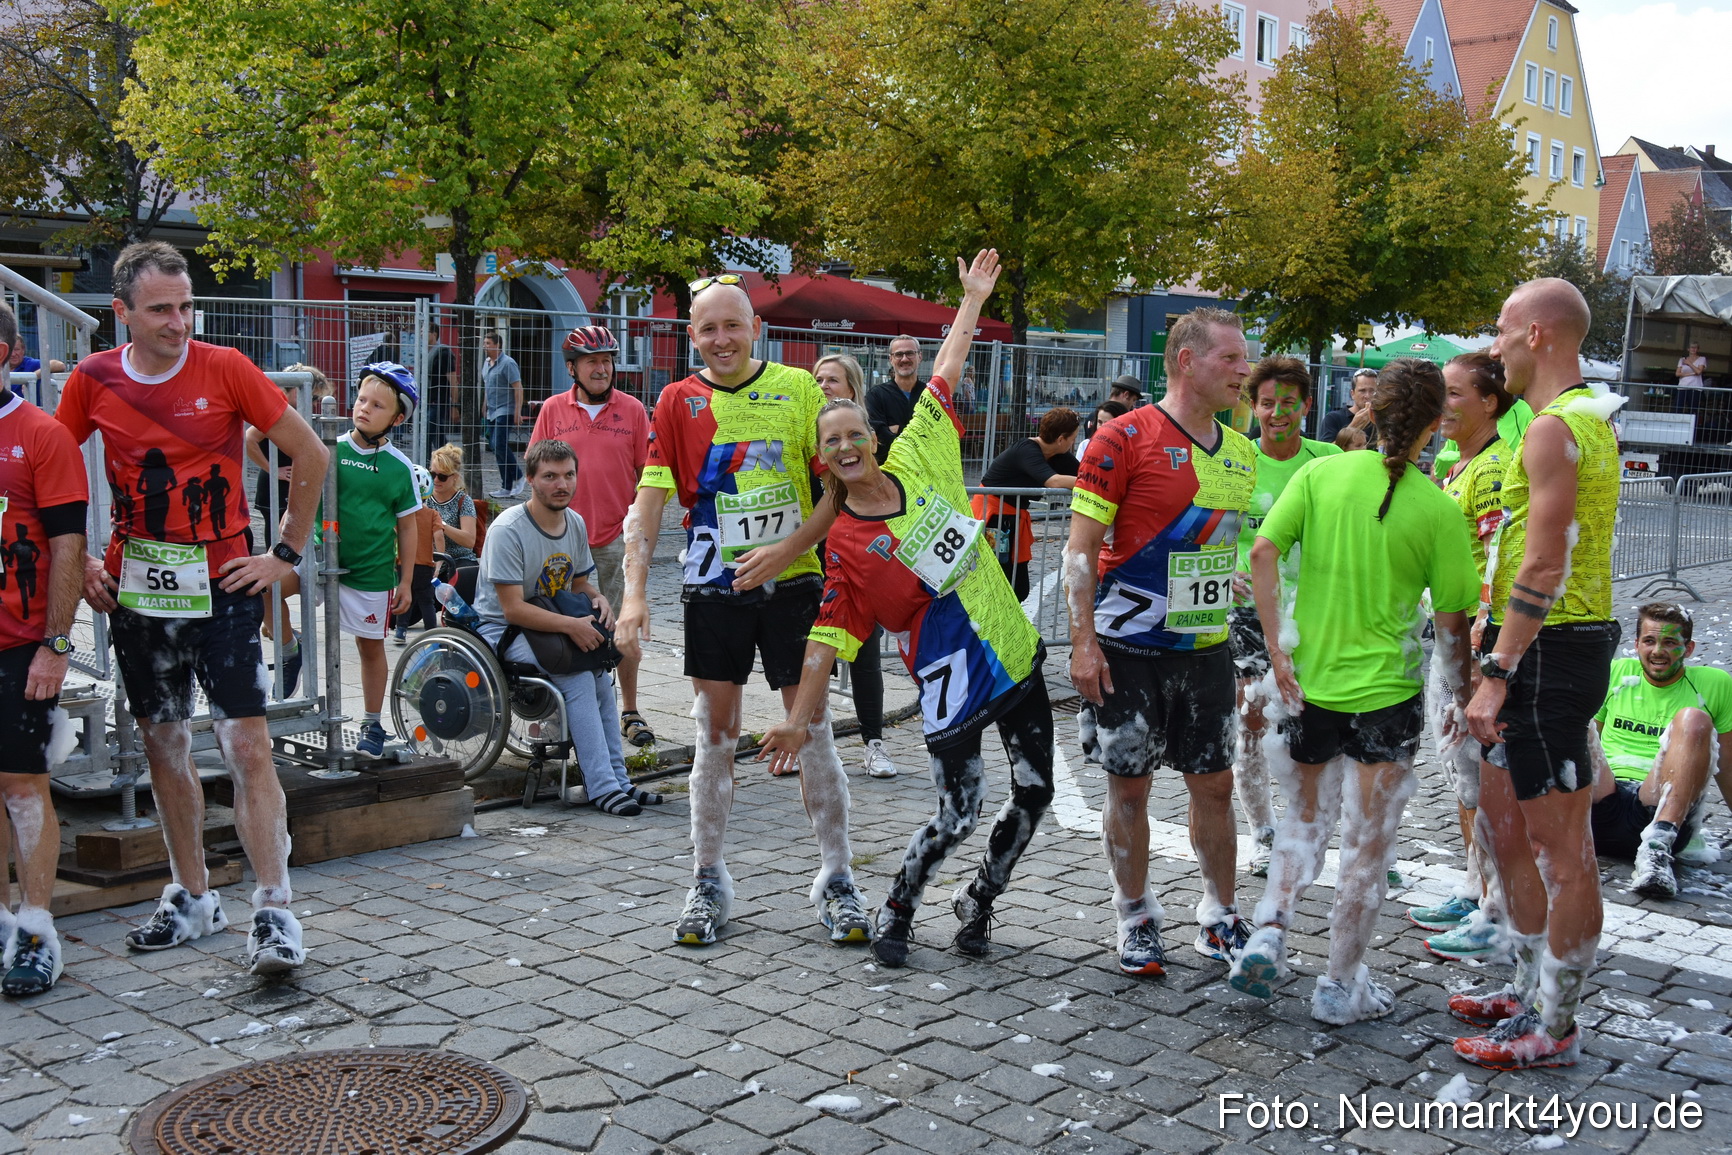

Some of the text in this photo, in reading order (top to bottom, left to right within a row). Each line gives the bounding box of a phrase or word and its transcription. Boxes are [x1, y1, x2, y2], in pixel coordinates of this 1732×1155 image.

[811, 318, 856, 330] Glossner-Bier
[553, 421, 581, 437] South
[340, 458, 379, 473] GIVOVA
[721, 484, 791, 511] BOCK
[1078, 493, 1109, 513] Motorsport
[737, 510, 784, 540] 177
[900, 500, 951, 562] BOCK
[129, 540, 199, 565] BOCK
[696, 532, 717, 577] 7
[933, 527, 966, 564] 88
[146, 567, 180, 591] 58
[1188, 578, 1231, 606] 181
[137, 596, 192, 608] MARTIN
[1107, 587, 1154, 632] 7
[923, 663, 953, 721] 7
[926, 708, 989, 743] www.bmw-partl.de
